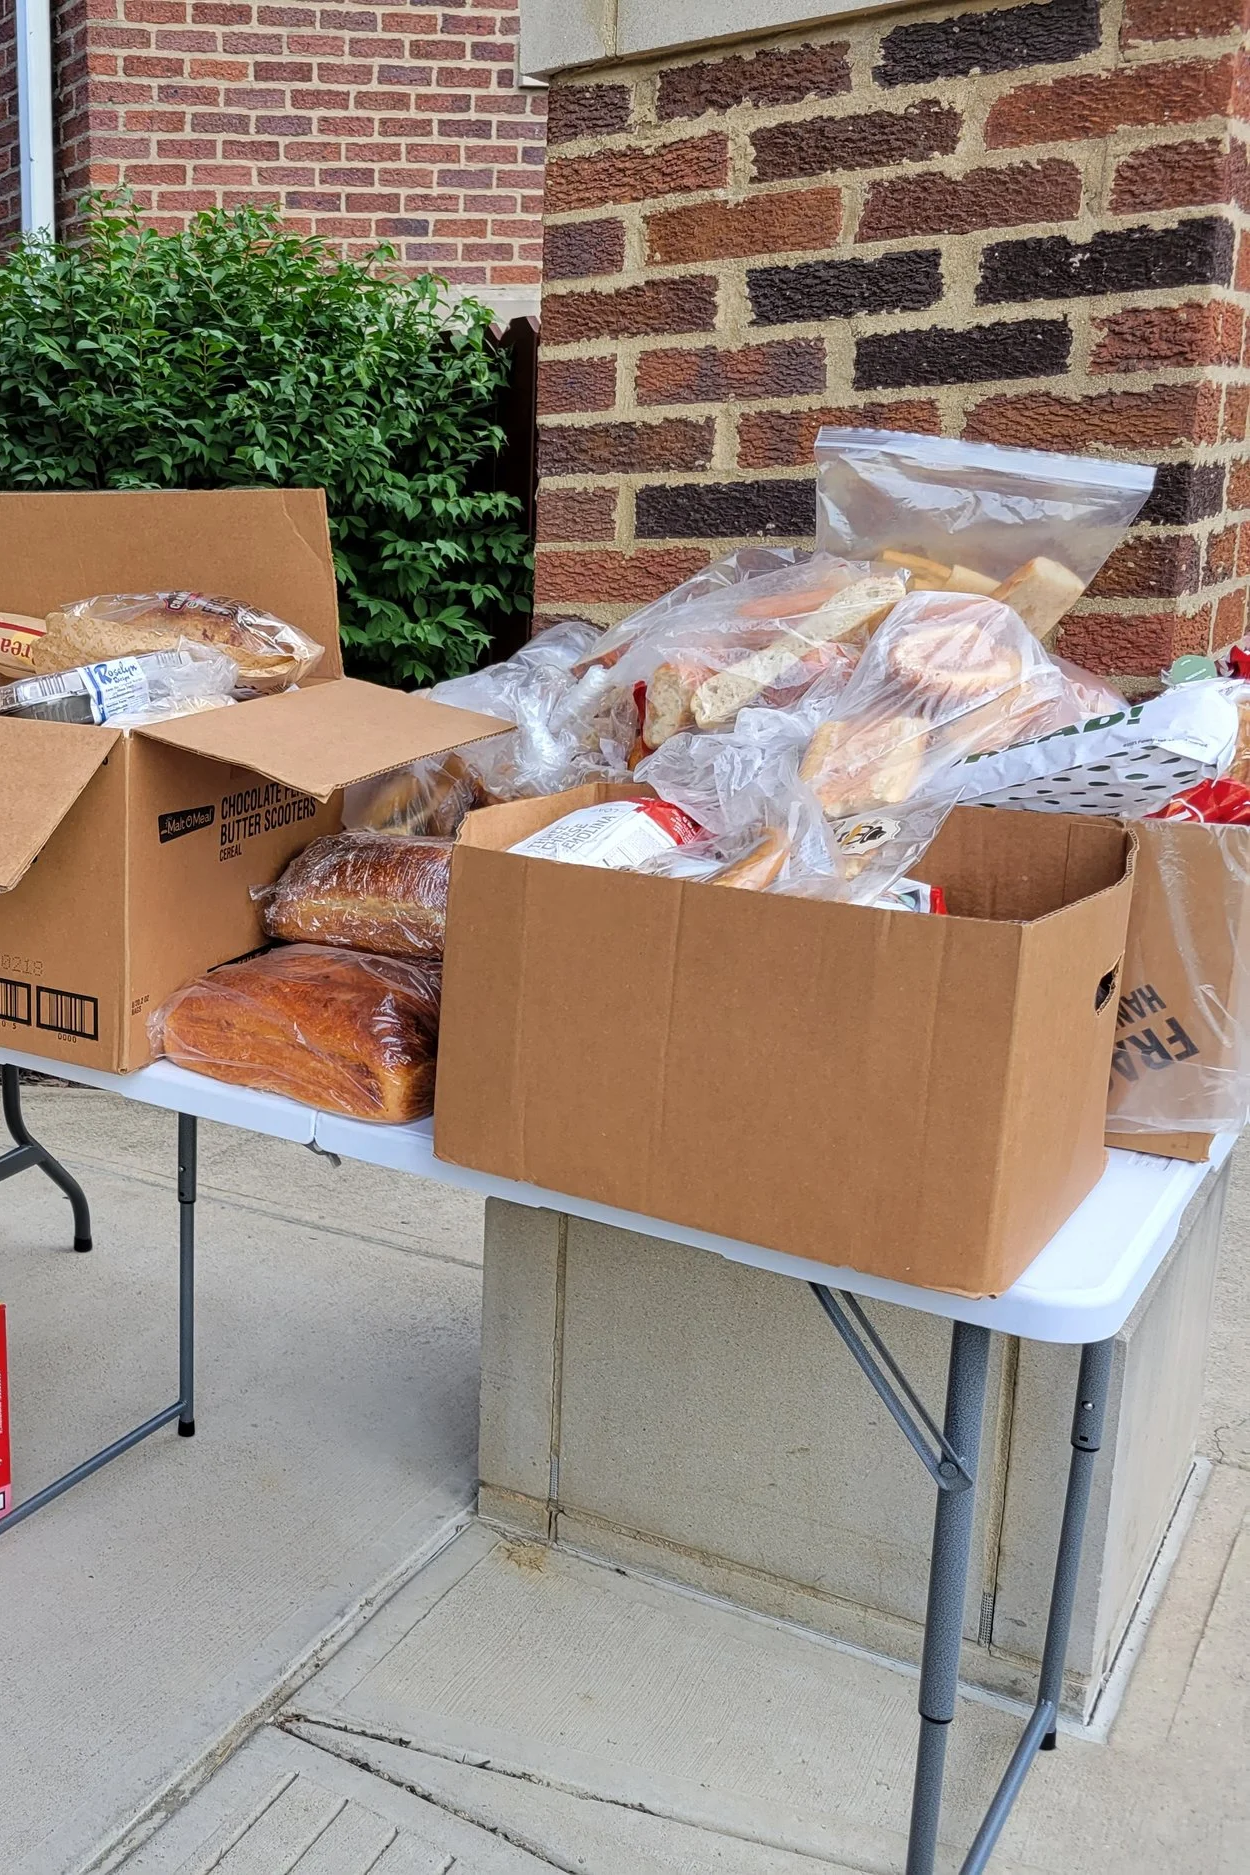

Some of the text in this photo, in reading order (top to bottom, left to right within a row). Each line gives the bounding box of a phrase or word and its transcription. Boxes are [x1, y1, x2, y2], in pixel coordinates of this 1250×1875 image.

[94, 661, 137, 684] Roselyn
[221, 783, 281, 820] CHOCOLATE
[220, 797, 316, 846] BUTTER SCOOTERS
[541, 823, 588, 850] CHEESE
[561, 815, 617, 850] EMOLINA
[219, 844, 242, 862] CEREAL
[1116, 984, 1167, 1029] HAN
[12, 1022, 17, 1030] 5
[57, 1033, 77, 1043] 0000
[1109, 1017, 1200, 1090] FRA
